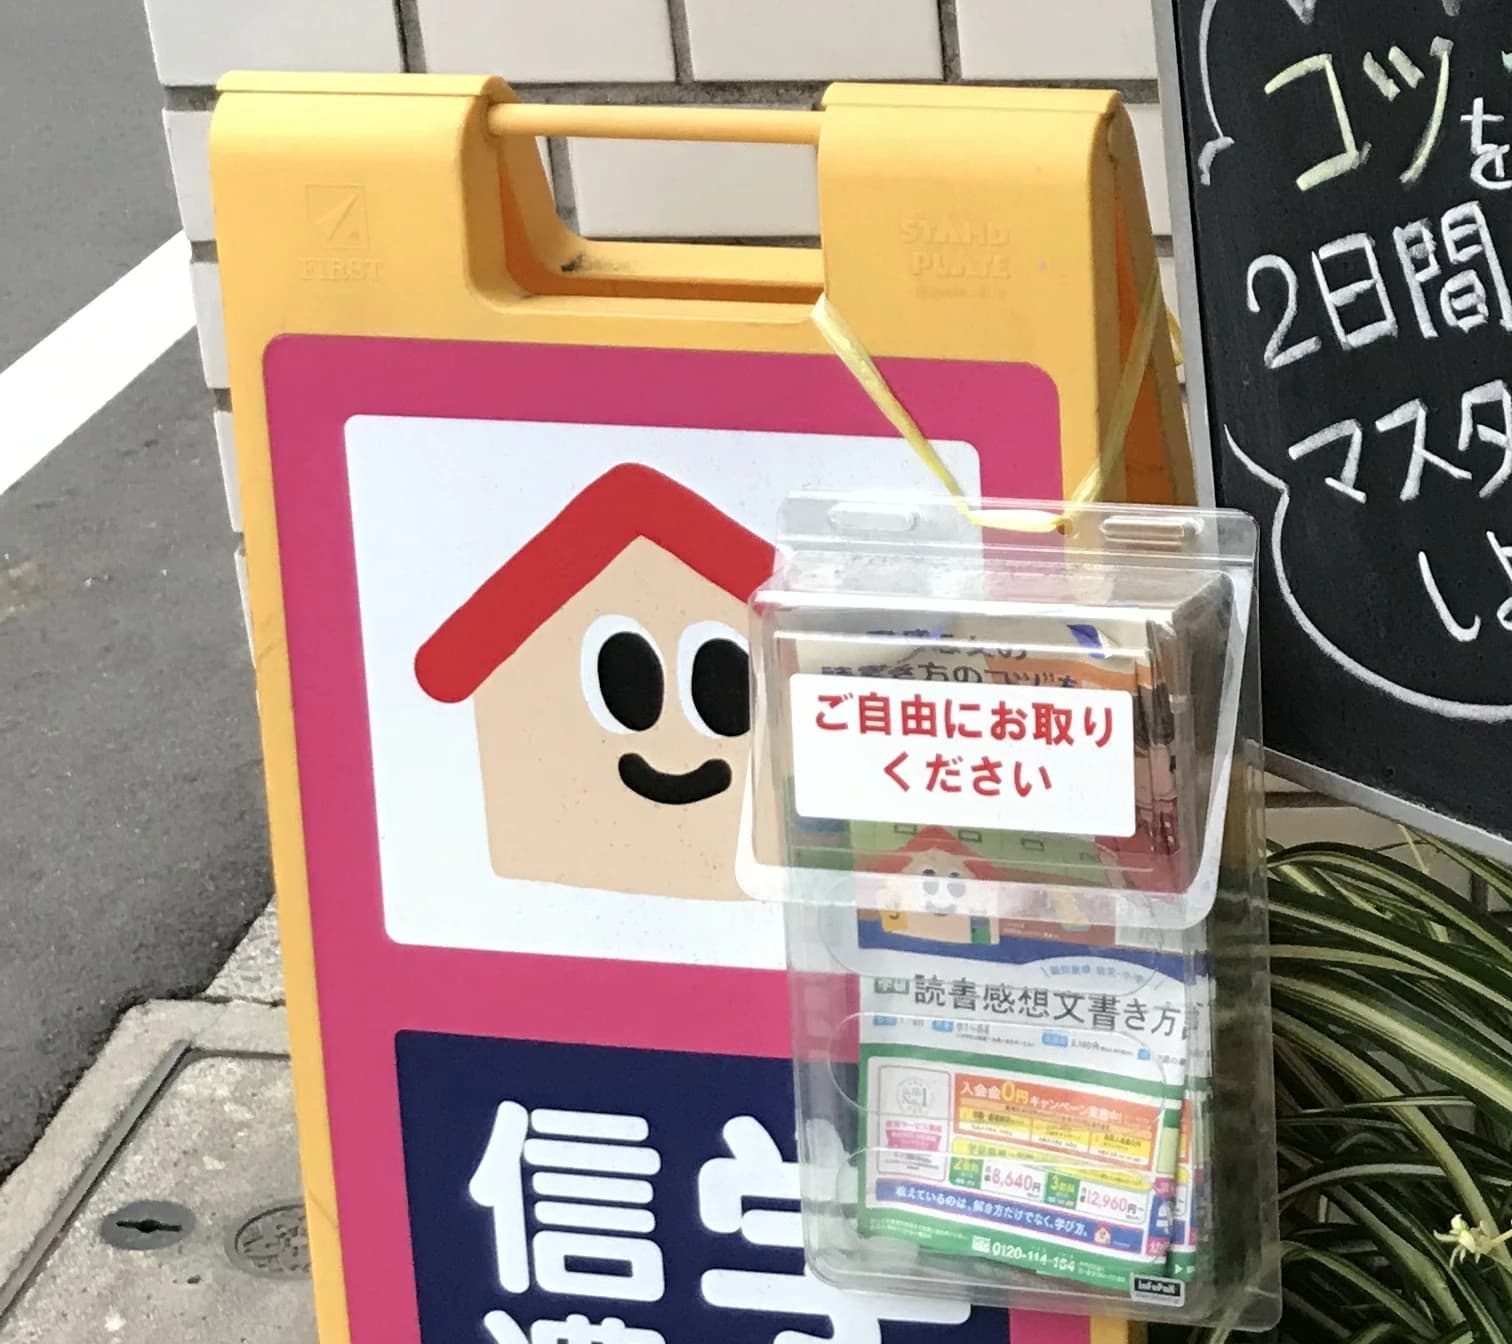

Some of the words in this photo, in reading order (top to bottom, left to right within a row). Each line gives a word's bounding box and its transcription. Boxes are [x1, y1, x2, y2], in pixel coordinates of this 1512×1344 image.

[814, 691, 1115, 749] ご自由にお取り
[882, 752, 1053, 798] ください
[913, 973, 1188, 1039] 読書感想文書き方
